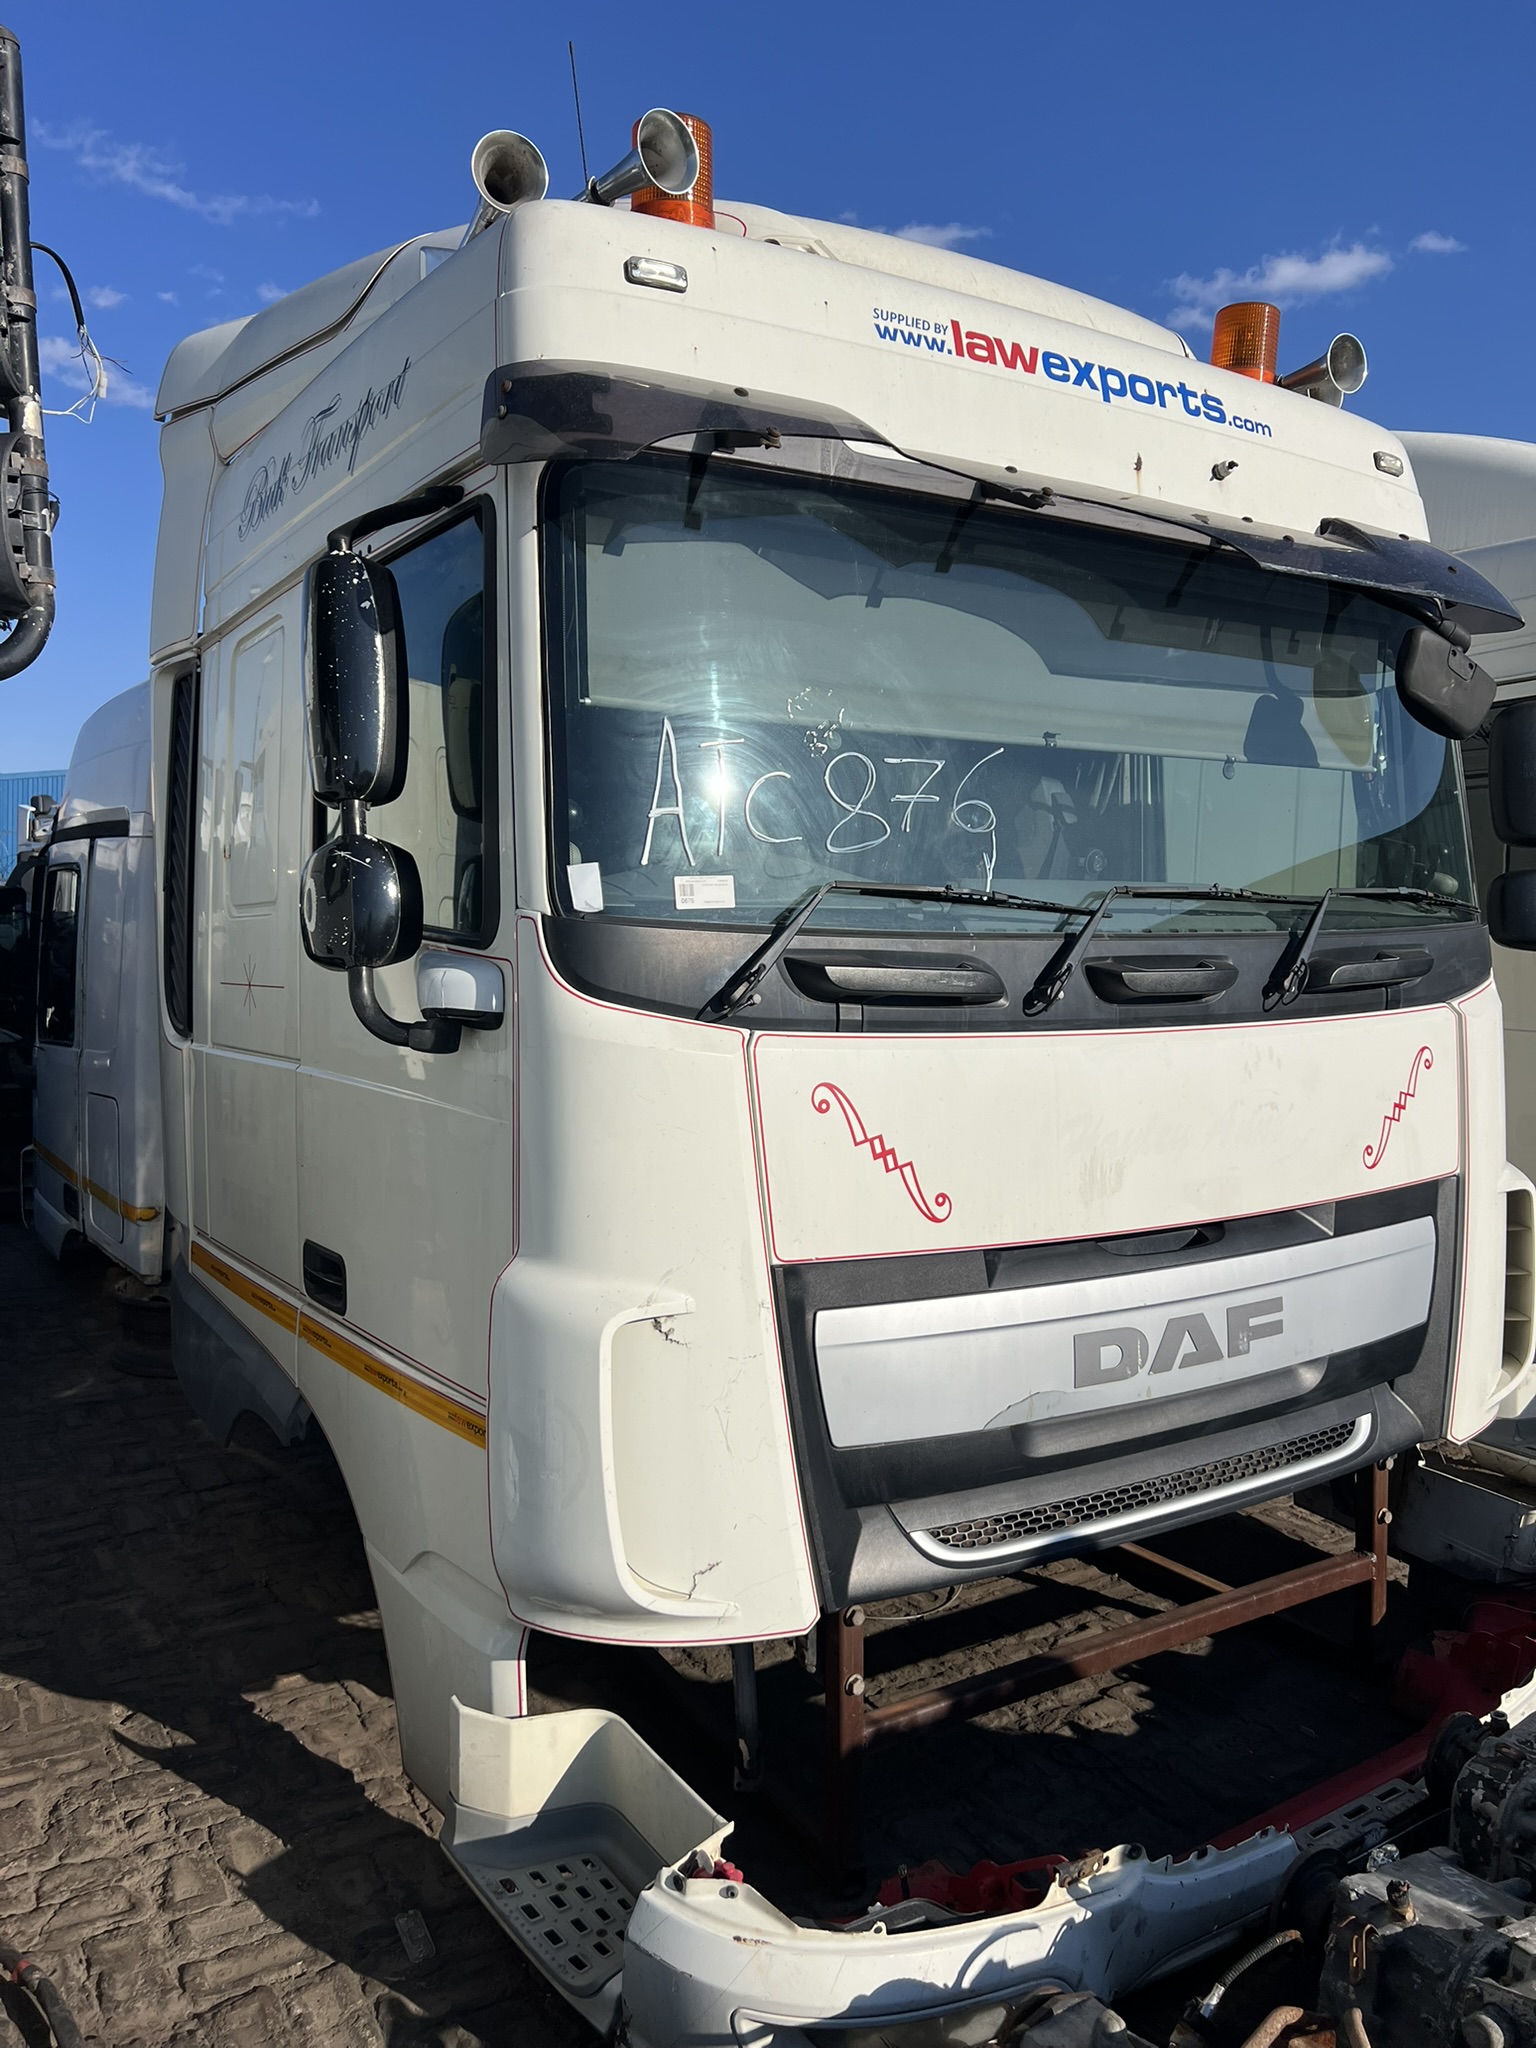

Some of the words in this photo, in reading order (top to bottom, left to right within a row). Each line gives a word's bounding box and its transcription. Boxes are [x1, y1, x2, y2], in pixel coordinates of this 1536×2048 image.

[873, 307, 931, 332] SUPPLIED
[933, 322, 949, 336] BY
[290, 355, 412, 495] Transport
[873, 318, 1273, 438] www.lawexports.com
[823, 746, 1005, 856] 876
[1072, 1295, 1285, 1390] DAF
